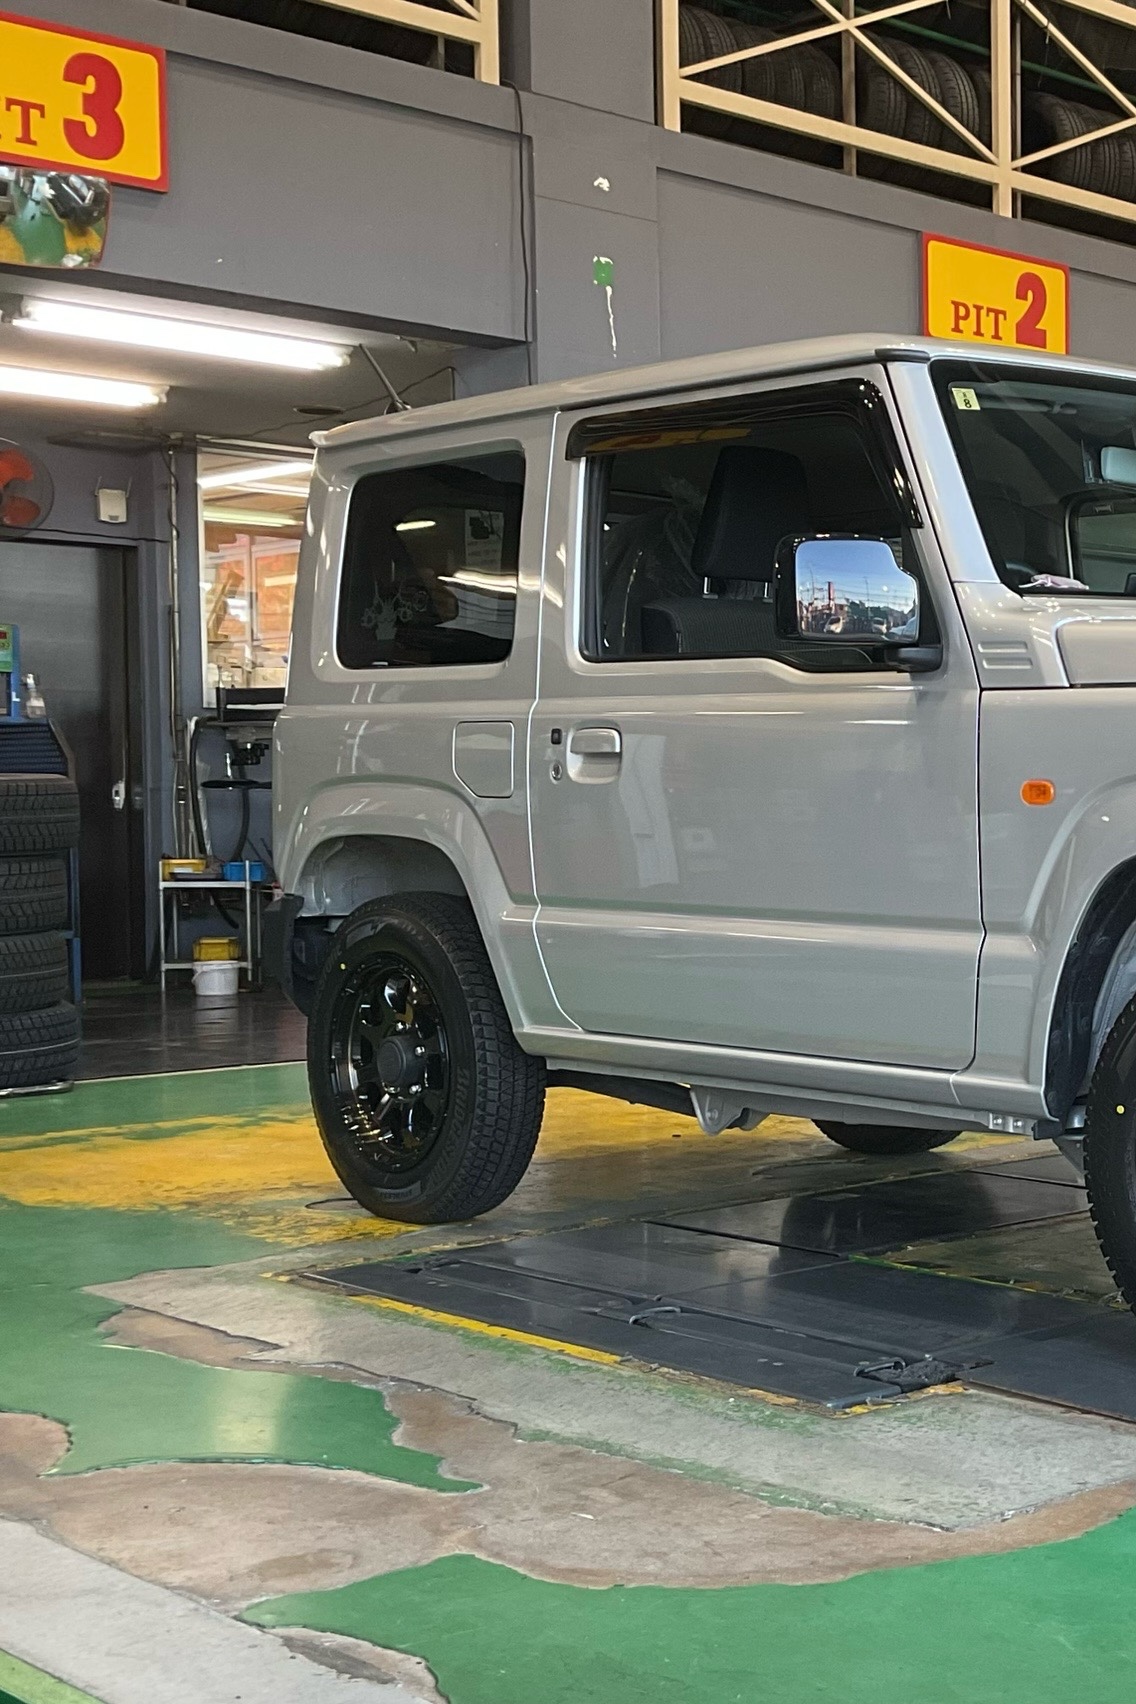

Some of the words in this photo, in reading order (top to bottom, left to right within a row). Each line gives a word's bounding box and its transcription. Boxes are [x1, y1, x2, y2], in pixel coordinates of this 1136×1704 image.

[62, 52, 125, 161] 3
[951, 300, 1007, 341] PIT
[1016, 271, 1047, 349] 2
[963, 398, 972, 408] 8
